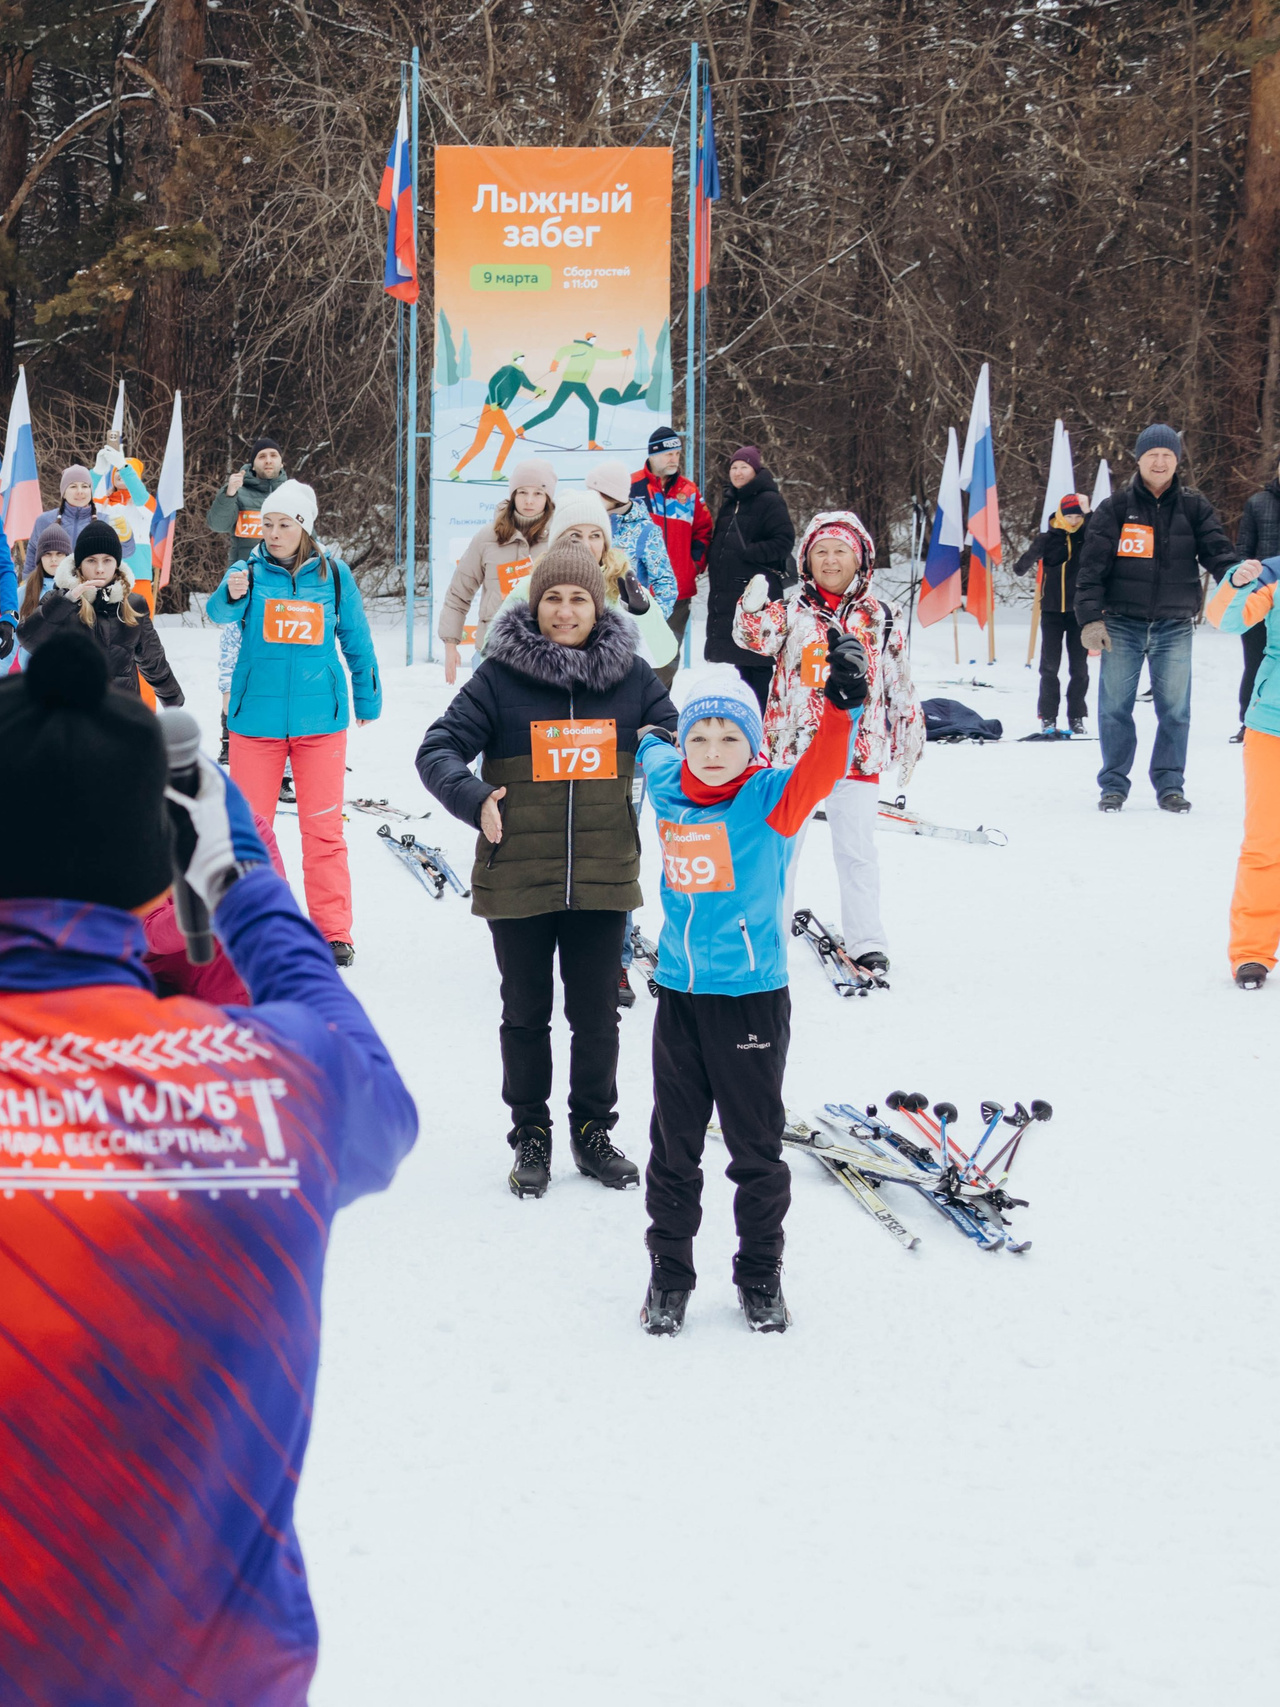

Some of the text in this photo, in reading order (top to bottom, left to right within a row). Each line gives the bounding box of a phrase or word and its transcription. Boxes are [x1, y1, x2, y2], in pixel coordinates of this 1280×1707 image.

[472, 183, 632, 213] Лыжный
[503, 216, 601, 248] забег
[483, 271, 539, 286] 9 марта
[563, 266, 631, 278] Сбор гостей
[563, 279, 599, 289] в 11:00
[286, 605, 315, 613] Goodline
[275, 619, 313, 640] 172
[811, 664, 832, 682] 16
[562, 726, 603, 735] Goodline
[548, 747, 601, 774] 179
[665, 855, 716, 885] 339
[118, 1081, 238, 1123] КЛУБ
[63, 1125, 247, 1158] БЕССМЕРТНЫХ
